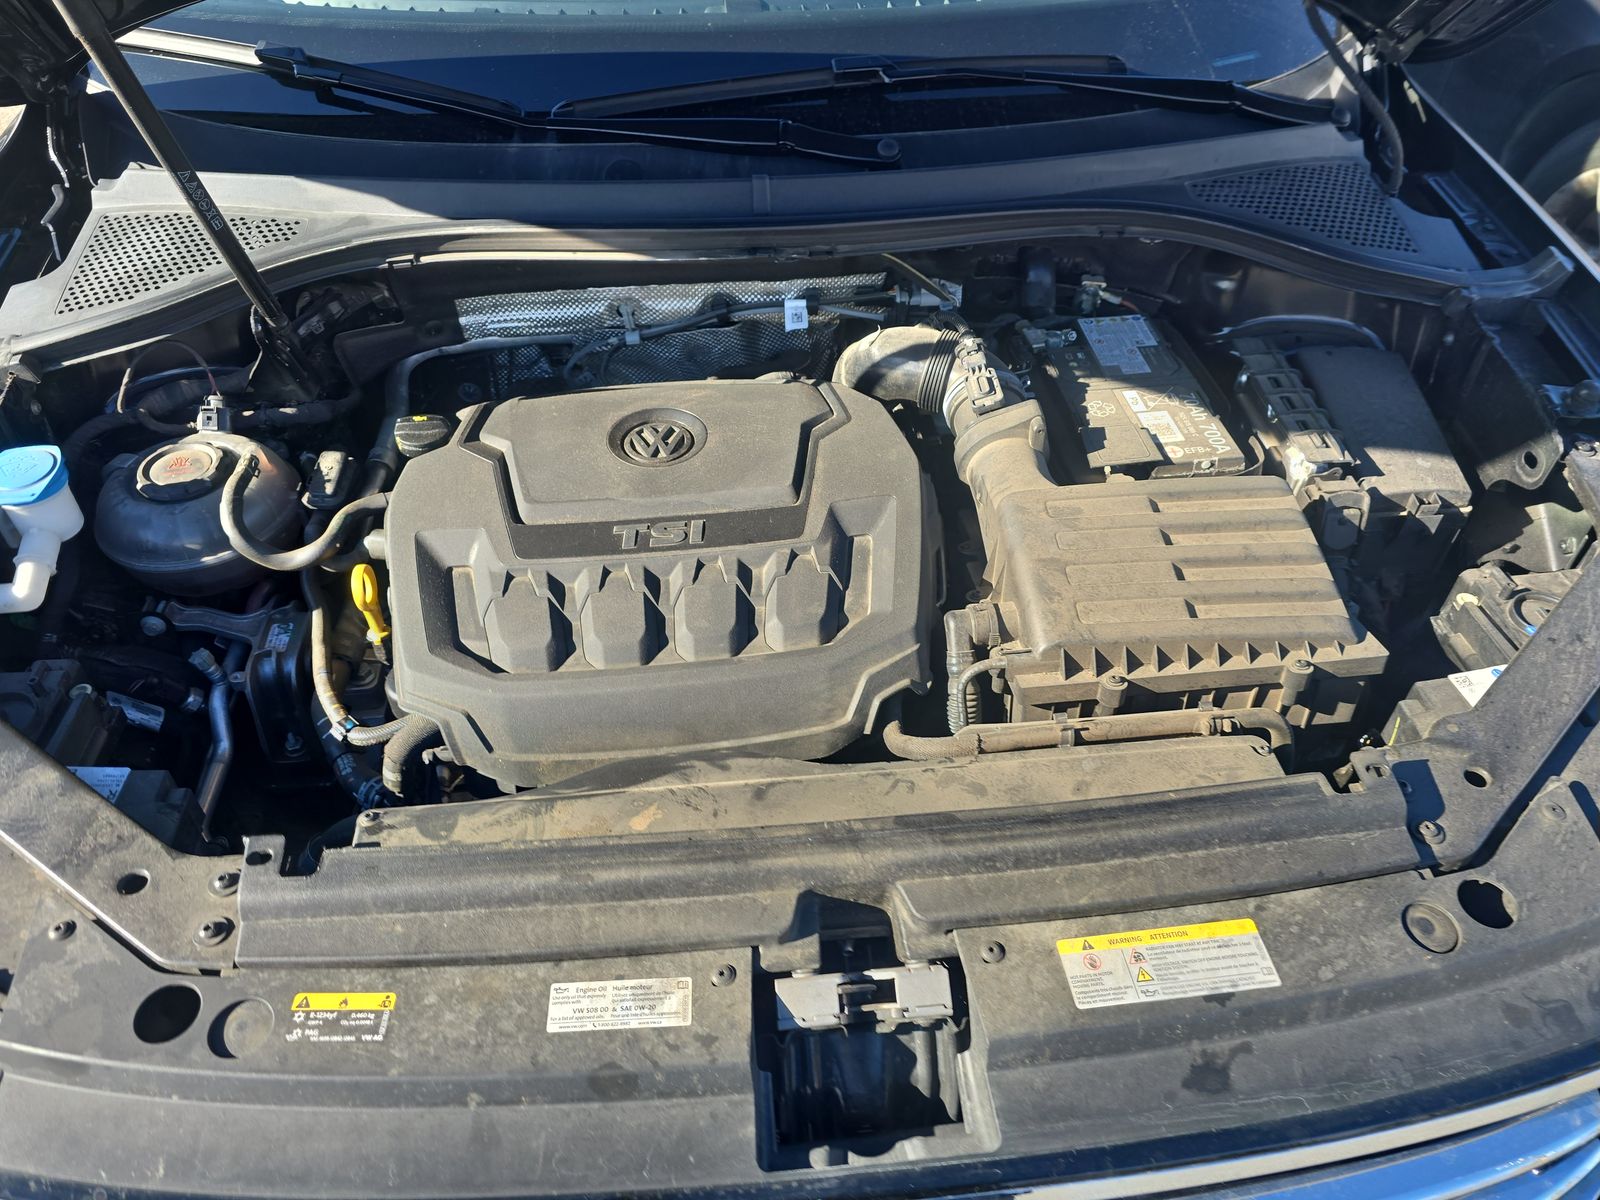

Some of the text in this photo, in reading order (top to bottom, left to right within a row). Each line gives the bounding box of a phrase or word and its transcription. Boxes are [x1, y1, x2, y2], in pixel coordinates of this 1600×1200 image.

[1181, 393, 1208, 421] 70Ah
[1200, 423, 1231, 454] 700A
[624, 422, 693, 463] VW
[613, 519, 706, 549] TSI
[1108, 930, 1189, 945] WARNING ATTENTION
[576, 986, 597, 995] Engine
